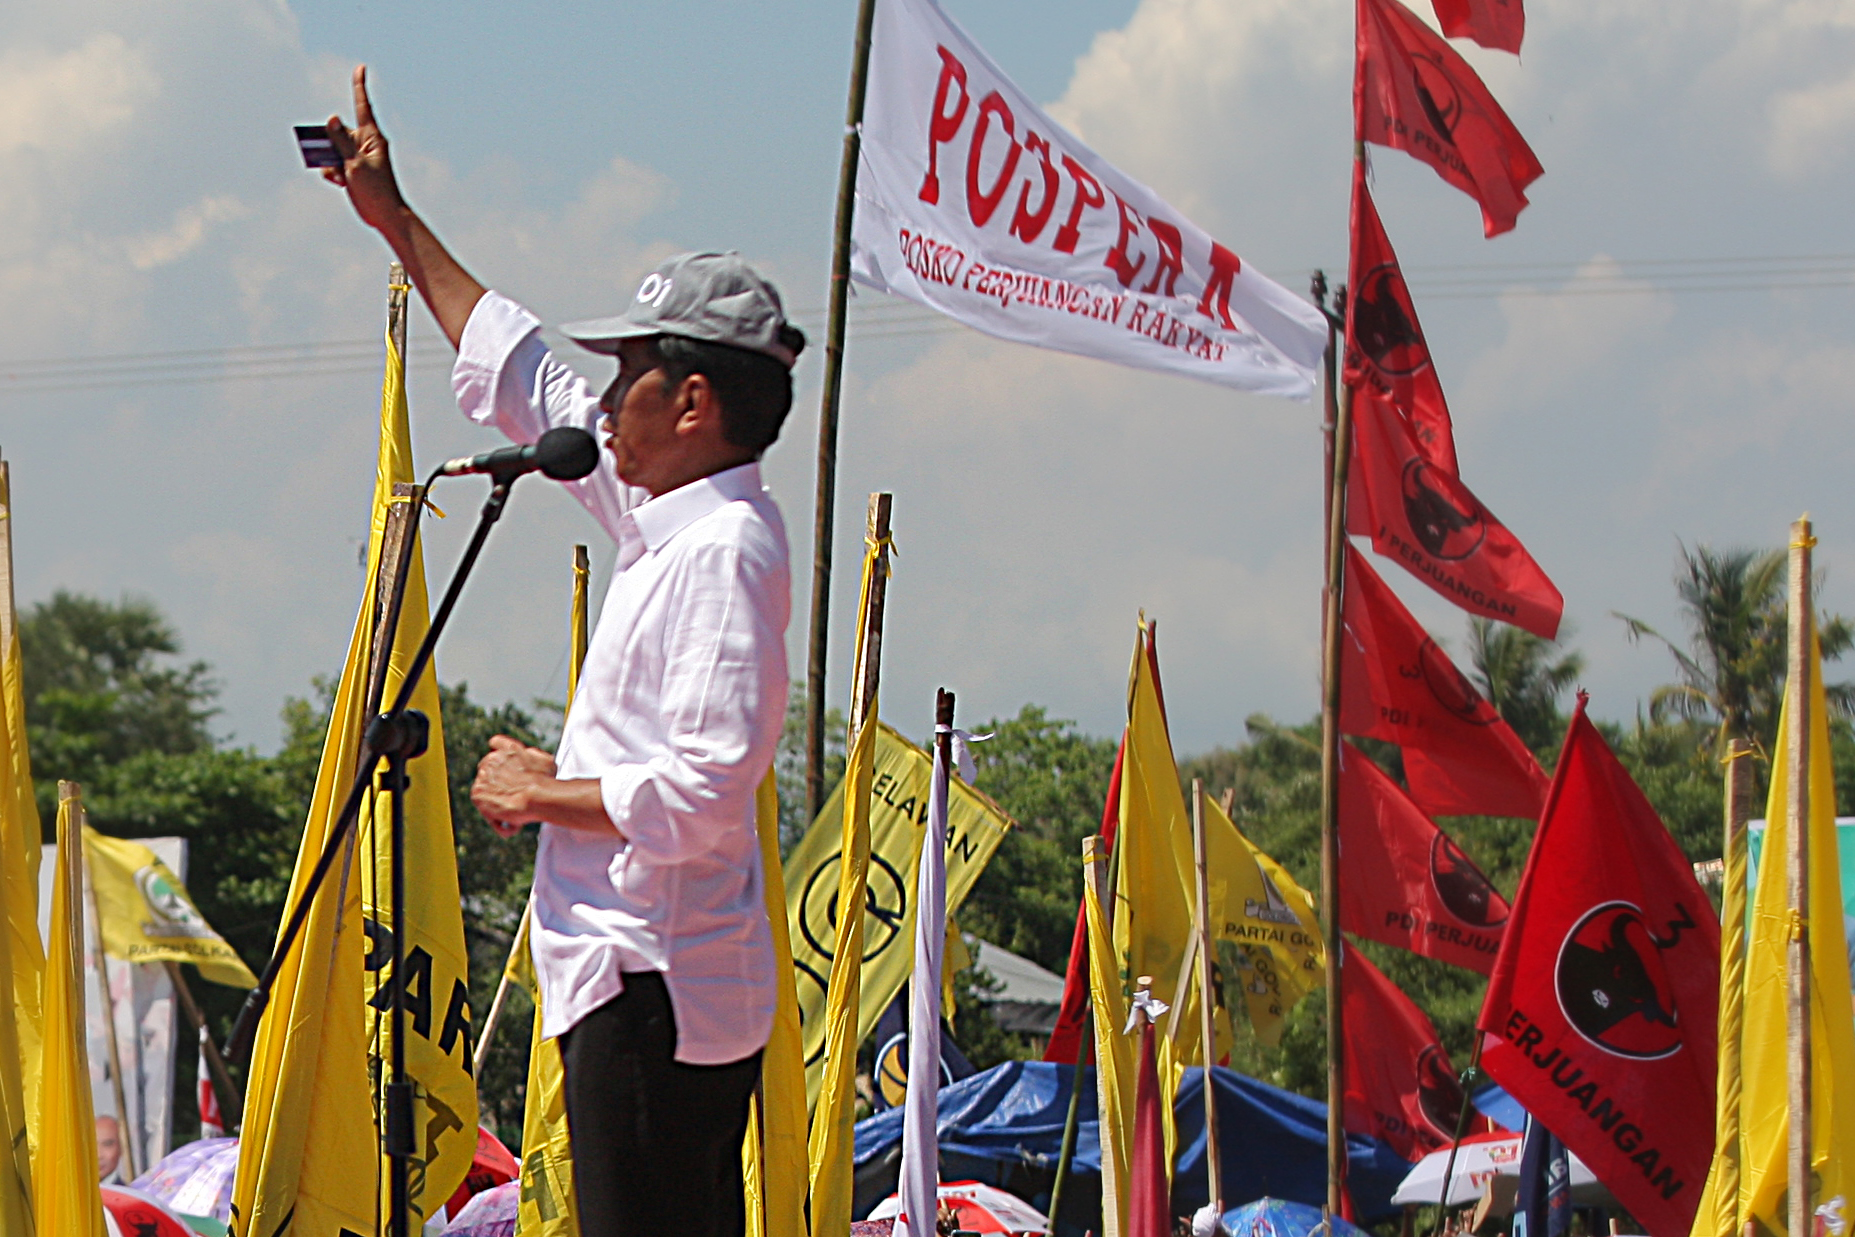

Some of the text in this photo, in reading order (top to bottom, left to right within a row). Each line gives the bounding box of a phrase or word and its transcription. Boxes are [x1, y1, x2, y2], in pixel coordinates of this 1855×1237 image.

[918, 43, 1240, 331] POSPERA
[1126, 298, 1229, 362] RAKYAT
[1389, 535, 1517, 618] PERJUANGAN
[1225, 921, 1285, 942] PARTAI
